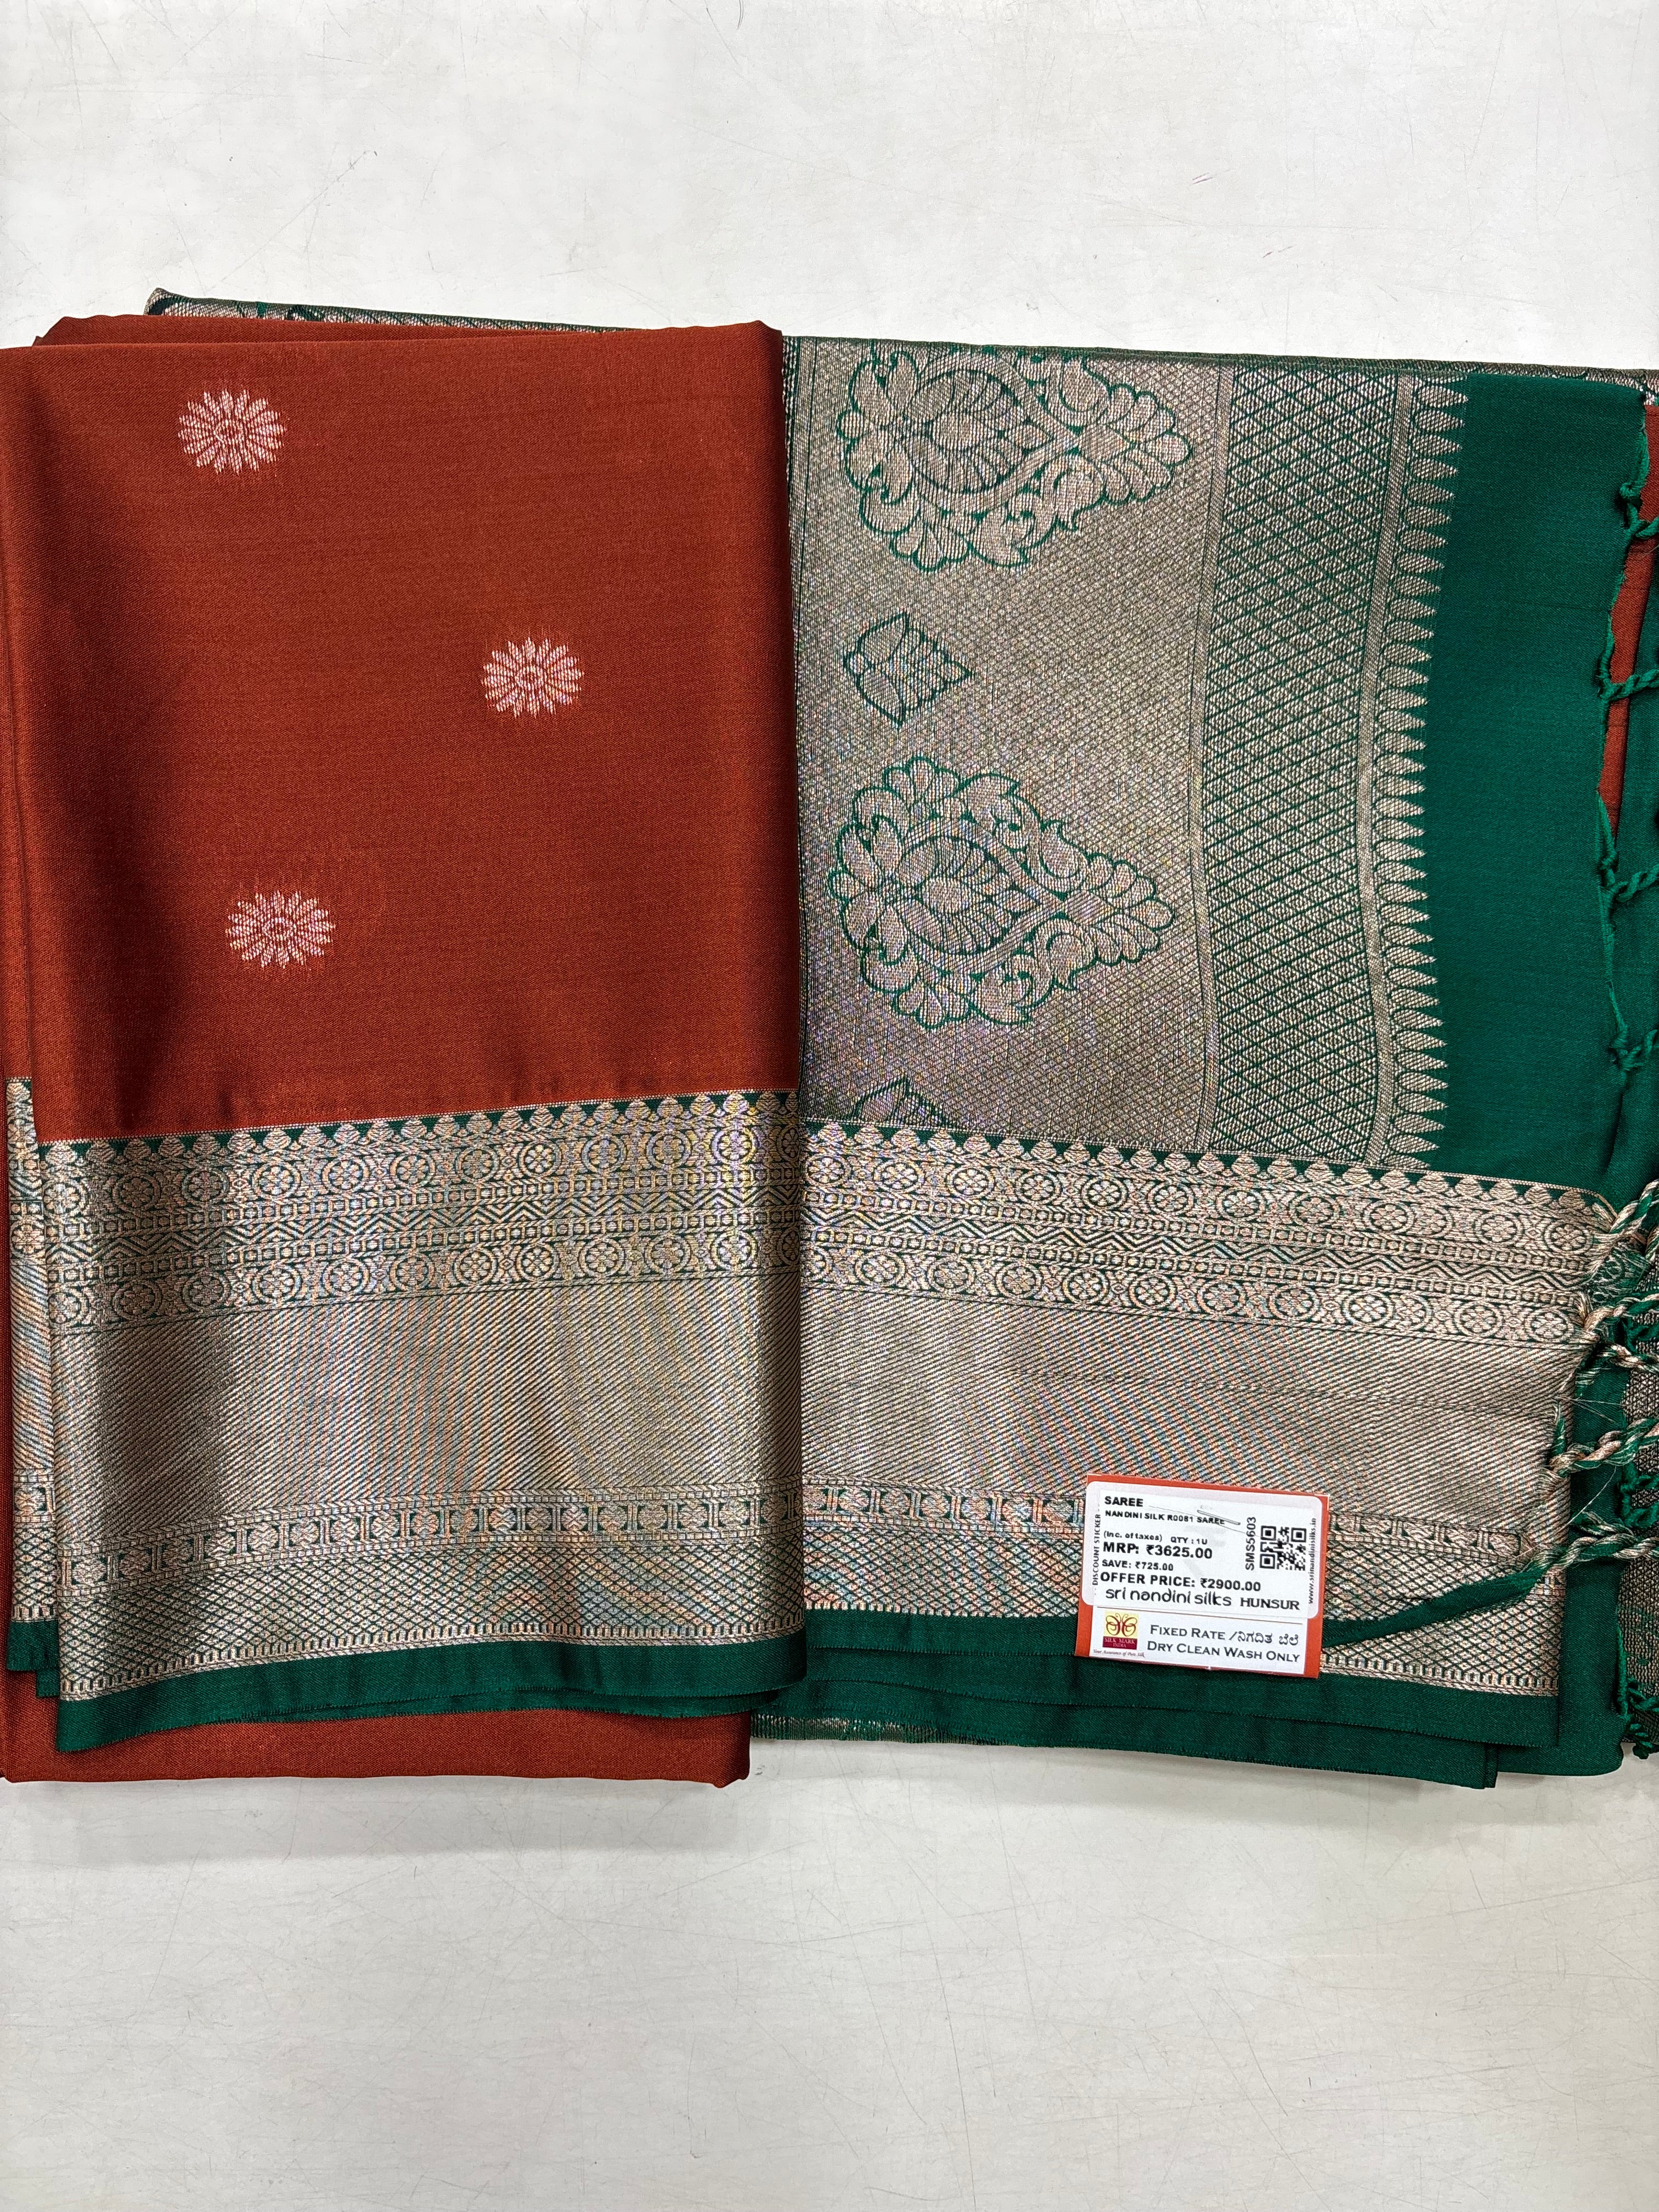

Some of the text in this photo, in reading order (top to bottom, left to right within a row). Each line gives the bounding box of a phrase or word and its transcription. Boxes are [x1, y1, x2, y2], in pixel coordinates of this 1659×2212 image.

[1104, 1496, 1143, 1507] SAREE
[1105, 1510, 1142, 1519] NANDINI
[1197, 1516, 1225, 1525] SAREE
[1103, 1530, 1122, 1538] (Inc.
[1133, 1533, 1163, 1542] taxes)
[1245, 1516, 1256, 1571] SMS5603
[1103, 1541, 1212, 1559] MRP: ₹3625.00
[1102, 1559, 1173, 1571] SAVE: ₹725.00
[1308, 1517, 1317, 1604] www.srinandinisilks.in
[1100, 1572, 1261, 1592] OFFER PRICE: ₹2900.00
[1105, 1587, 1232, 1606] sri nandini silks
[1240, 1597, 1300, 1611] HUNSUR
[1278, 1633, 1299, 1646] ಬೆಲೆ
